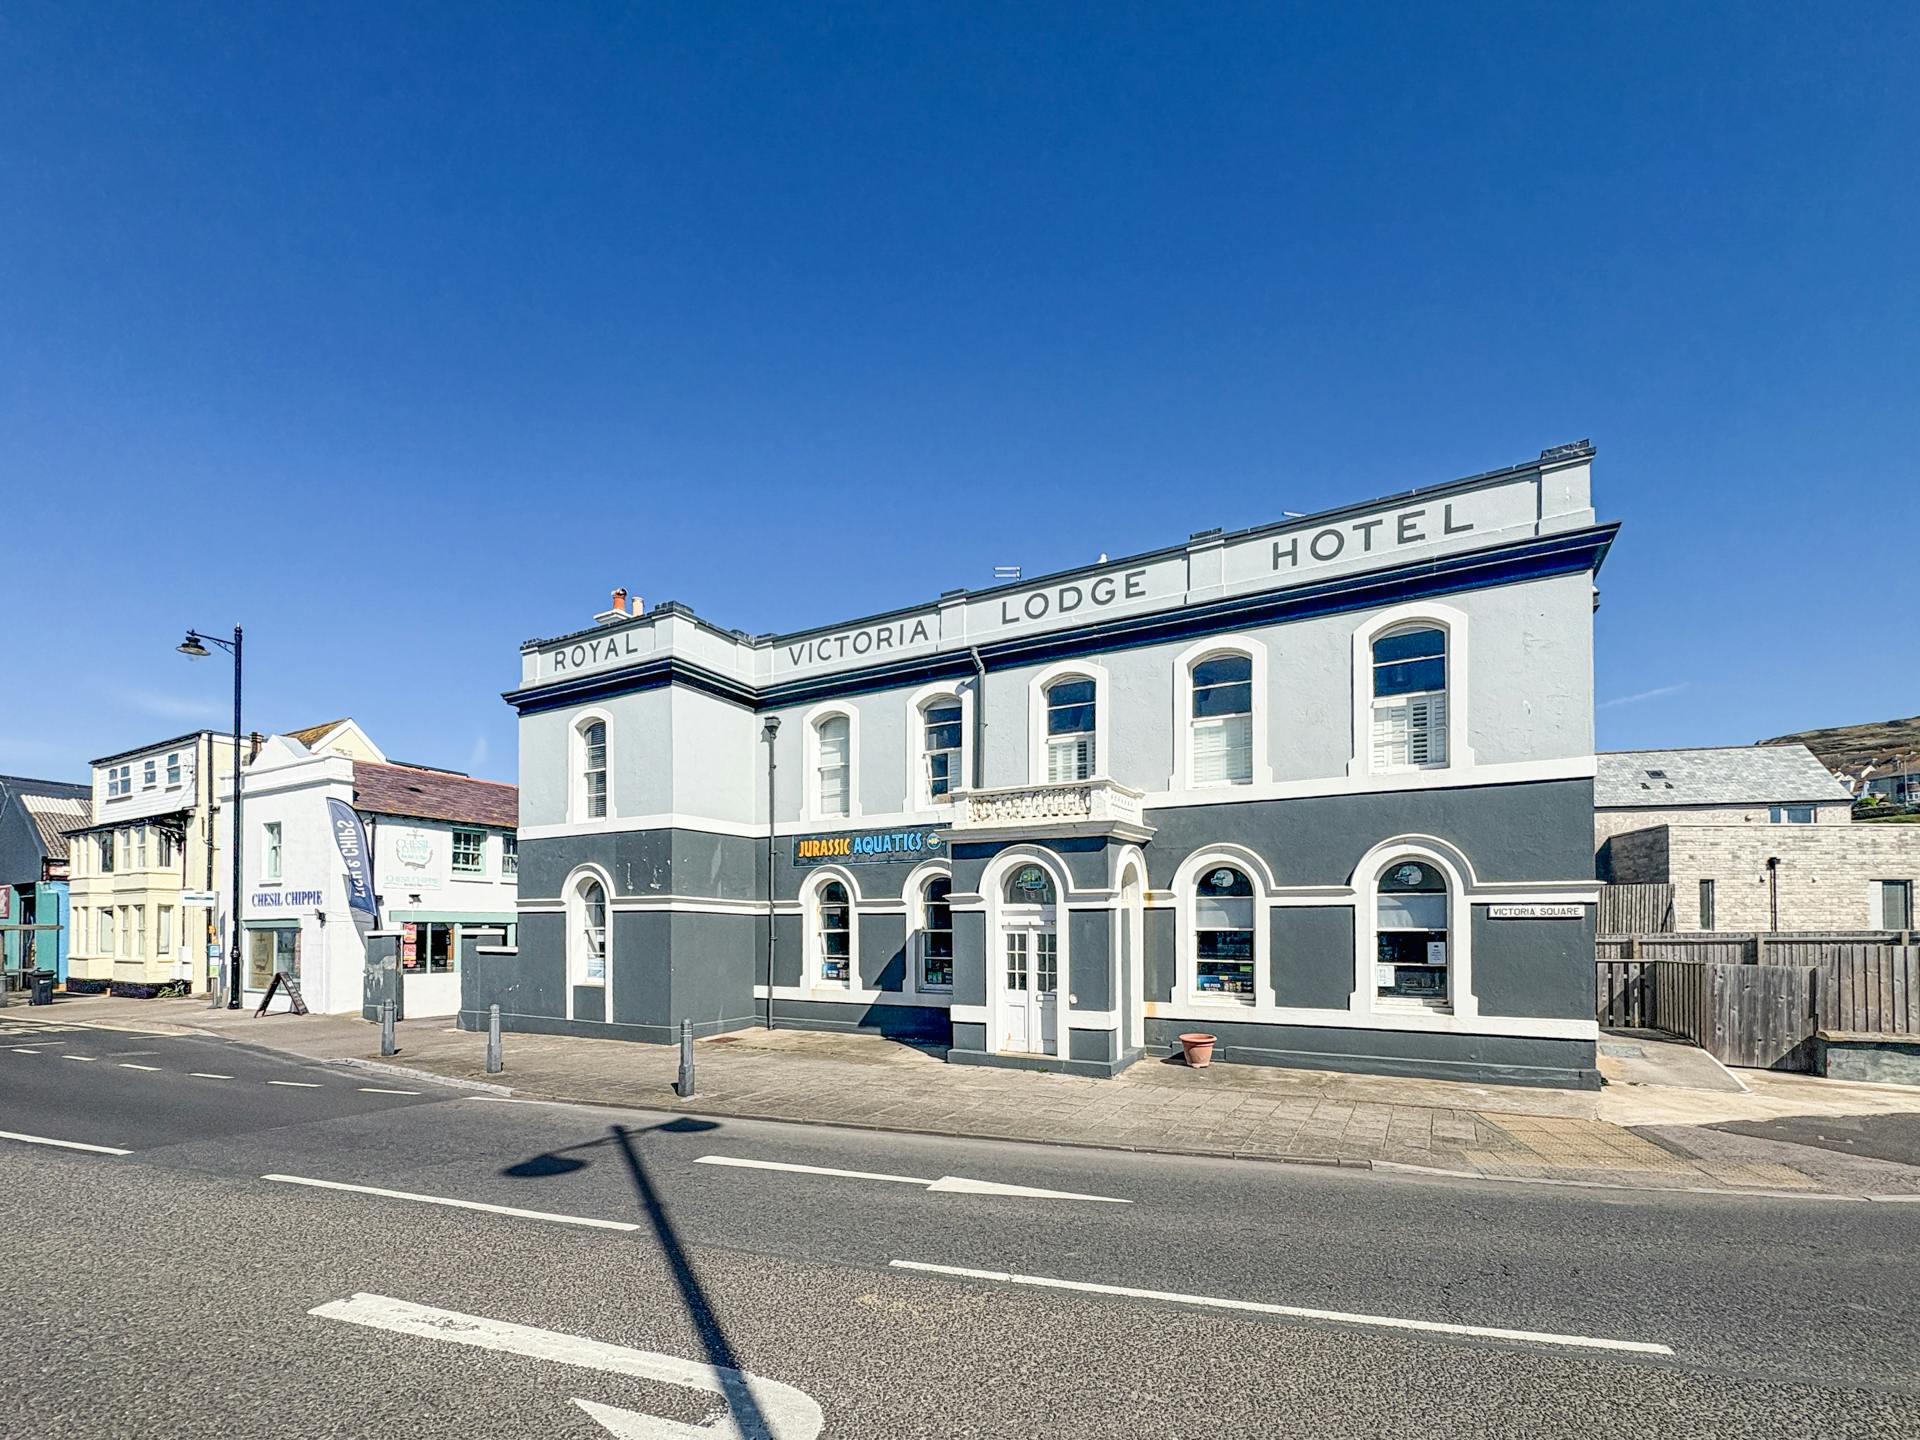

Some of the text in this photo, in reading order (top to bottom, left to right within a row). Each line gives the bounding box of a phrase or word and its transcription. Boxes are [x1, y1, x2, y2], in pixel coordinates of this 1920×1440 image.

[554, 503, 1474, 672] ROYAL VICTORIA LODGE HOTEL
[798, 832, 922, 858] JURASSIC AQUATICS
[251, 890, 323, 908] CHESIL CHIPPIE
[1492, 907, 1581, 916] VICTORIA SQUARE
